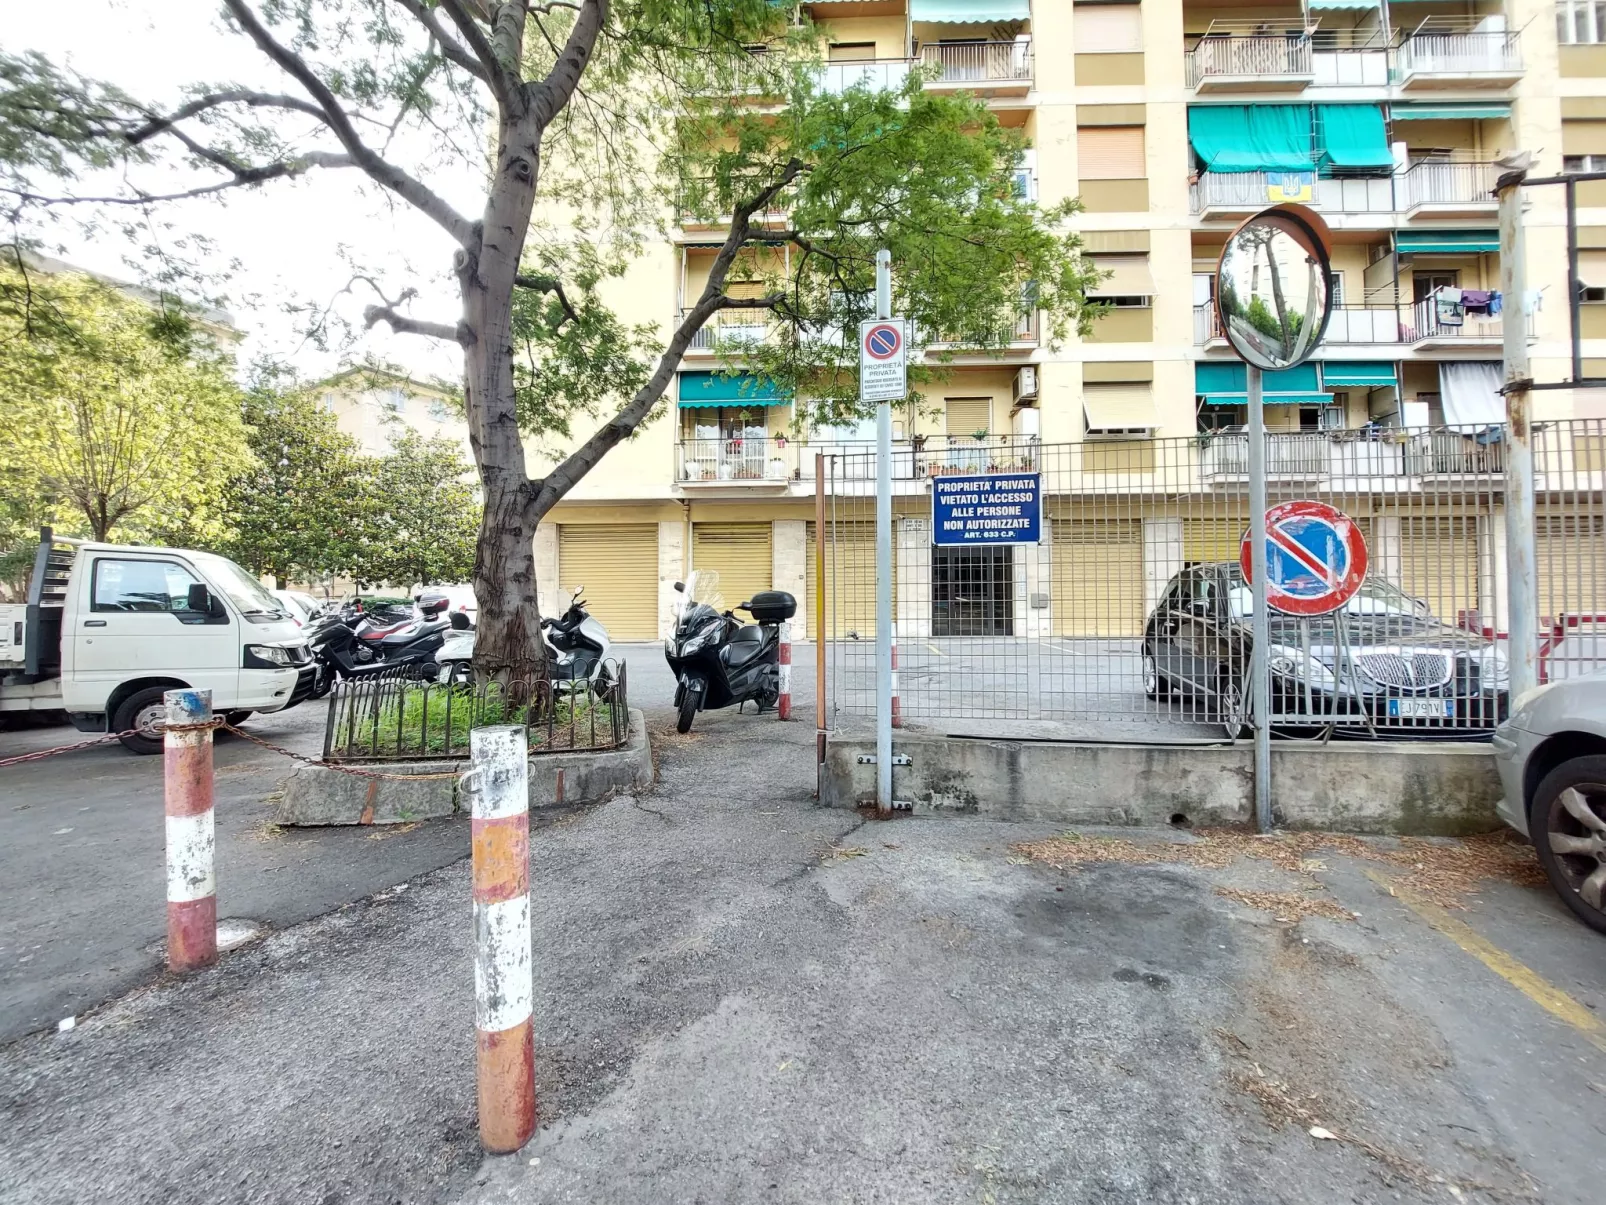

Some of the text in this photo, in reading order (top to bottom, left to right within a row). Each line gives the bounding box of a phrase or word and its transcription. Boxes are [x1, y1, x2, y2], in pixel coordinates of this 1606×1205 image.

[938, 480, 1036, 492] PROPRIETA' PRIVATA
[940, 492, 1033, 505] VIETATO L'ACCESSO
[951, 506, 1022, 518] ALLE PERSONE
[944, 518, 1030, 530] NON AUTORIZZATE
[964, 531, 982, 539] ART.
[1000, 530, 1016, 538] C.P.
